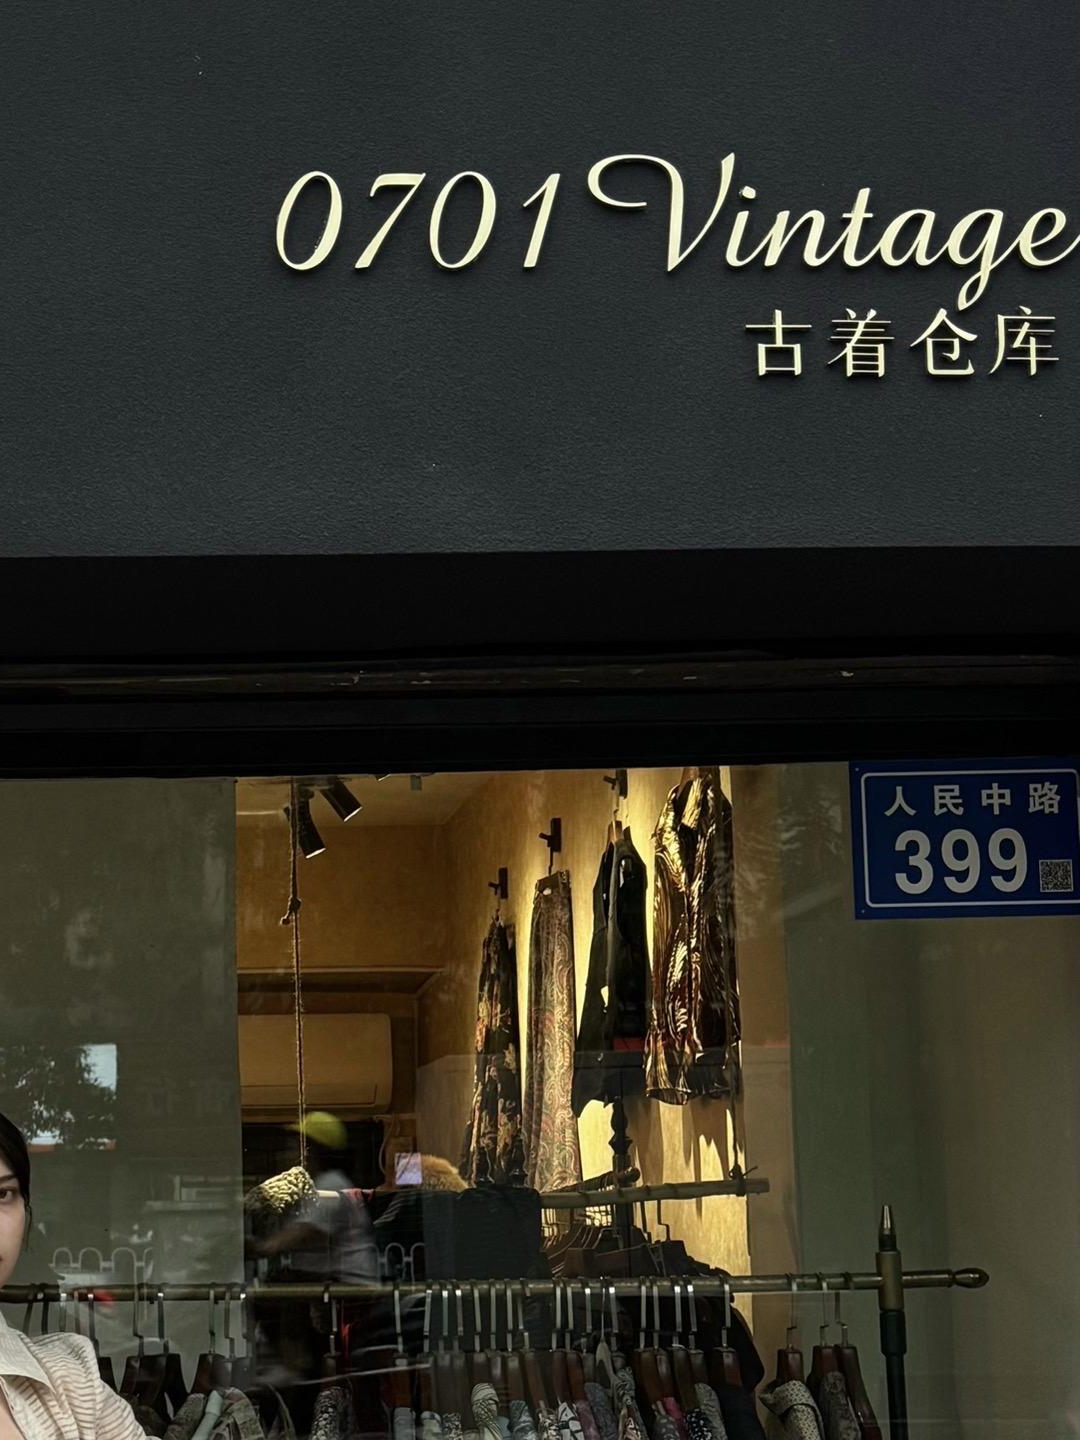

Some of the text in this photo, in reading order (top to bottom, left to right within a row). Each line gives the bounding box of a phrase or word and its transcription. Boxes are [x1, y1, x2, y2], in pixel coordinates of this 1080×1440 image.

[275, 151, 1080, 311] 0701 Vintage
[745, 305, 1060, 378] 古着仓库
[883, 781, 1061, 817] 人民中路
[894, 827, 1028, 895] 399
